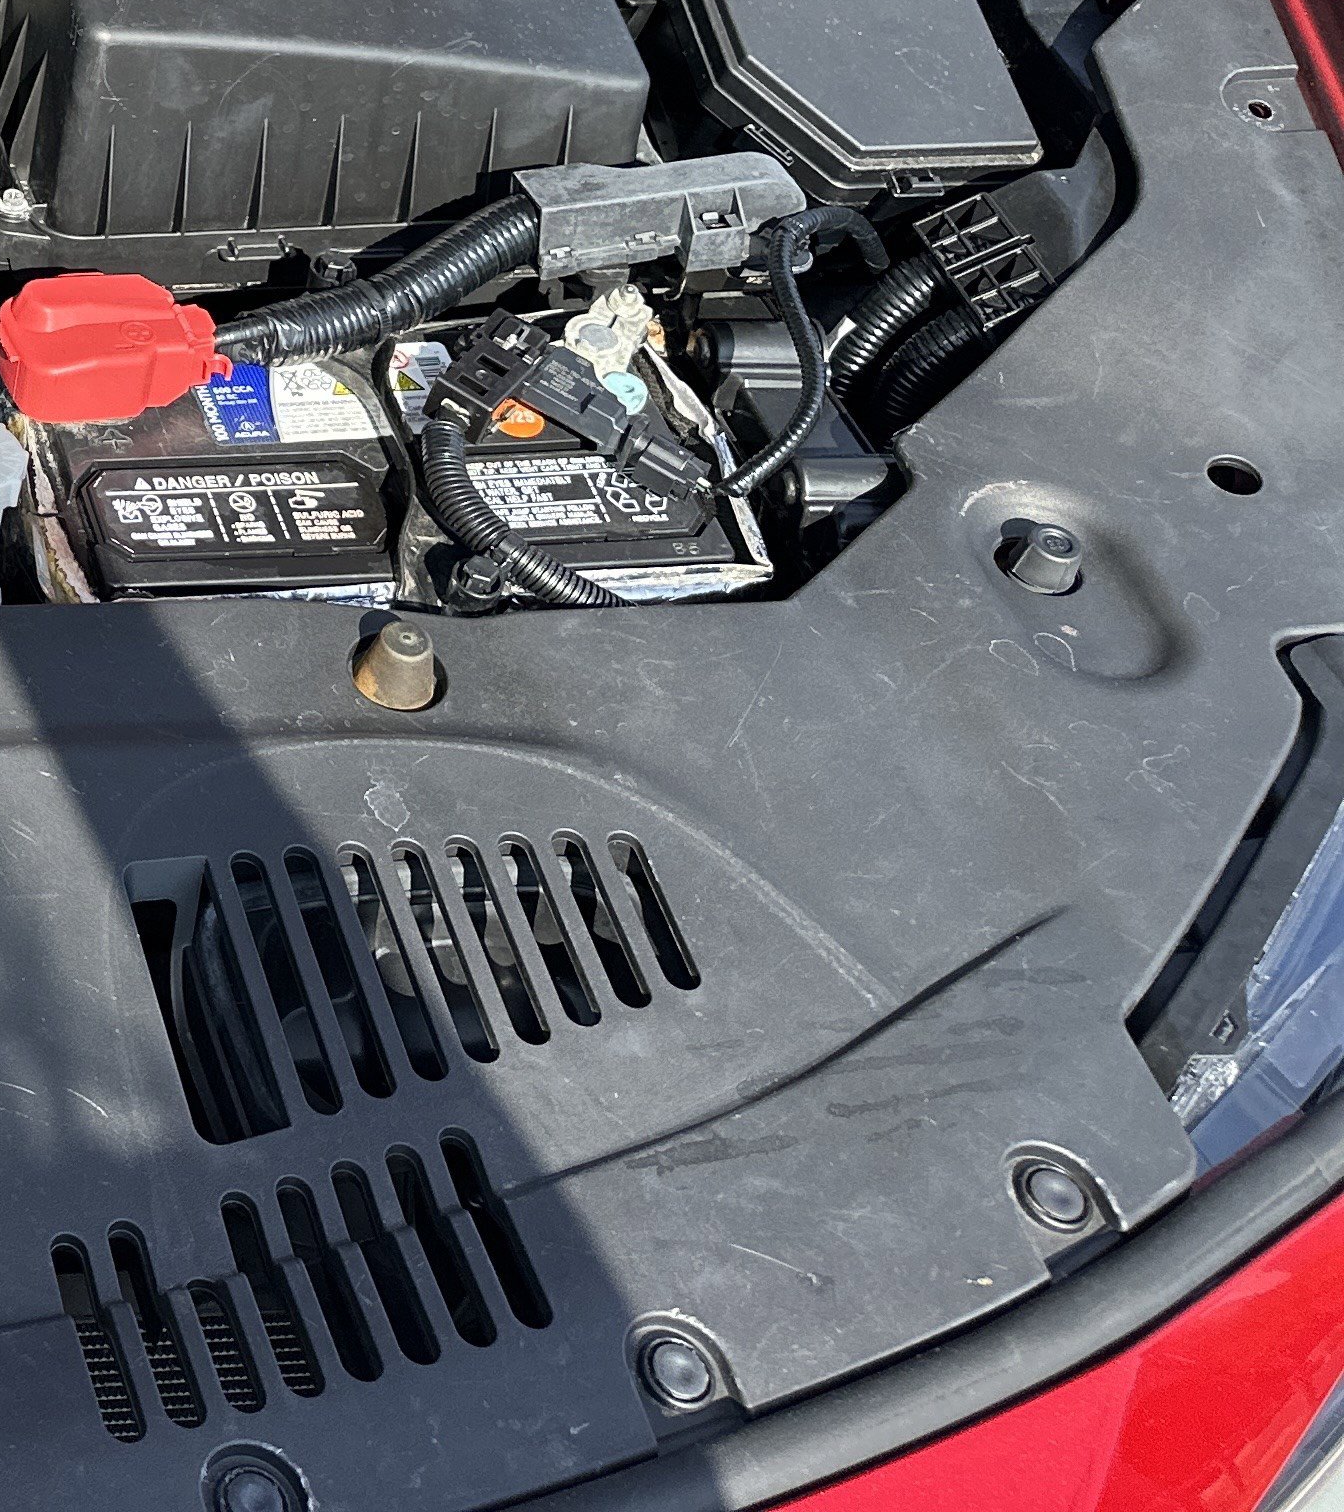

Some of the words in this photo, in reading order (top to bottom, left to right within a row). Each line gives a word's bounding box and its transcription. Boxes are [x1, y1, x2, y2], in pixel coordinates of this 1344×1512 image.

[194, 385, 222, 424] MONTH
[212, 423, 230, 441] 100
[234, 430, 271, 438] ACURA
[152, 474, 230, 490] DANGER
[234, 473, 244, 487] /
[248, 472, 320, 486] POISON
[512, 475, 572, 487] IMMEDIATELY
[341, 509, 365, 518] ACID
